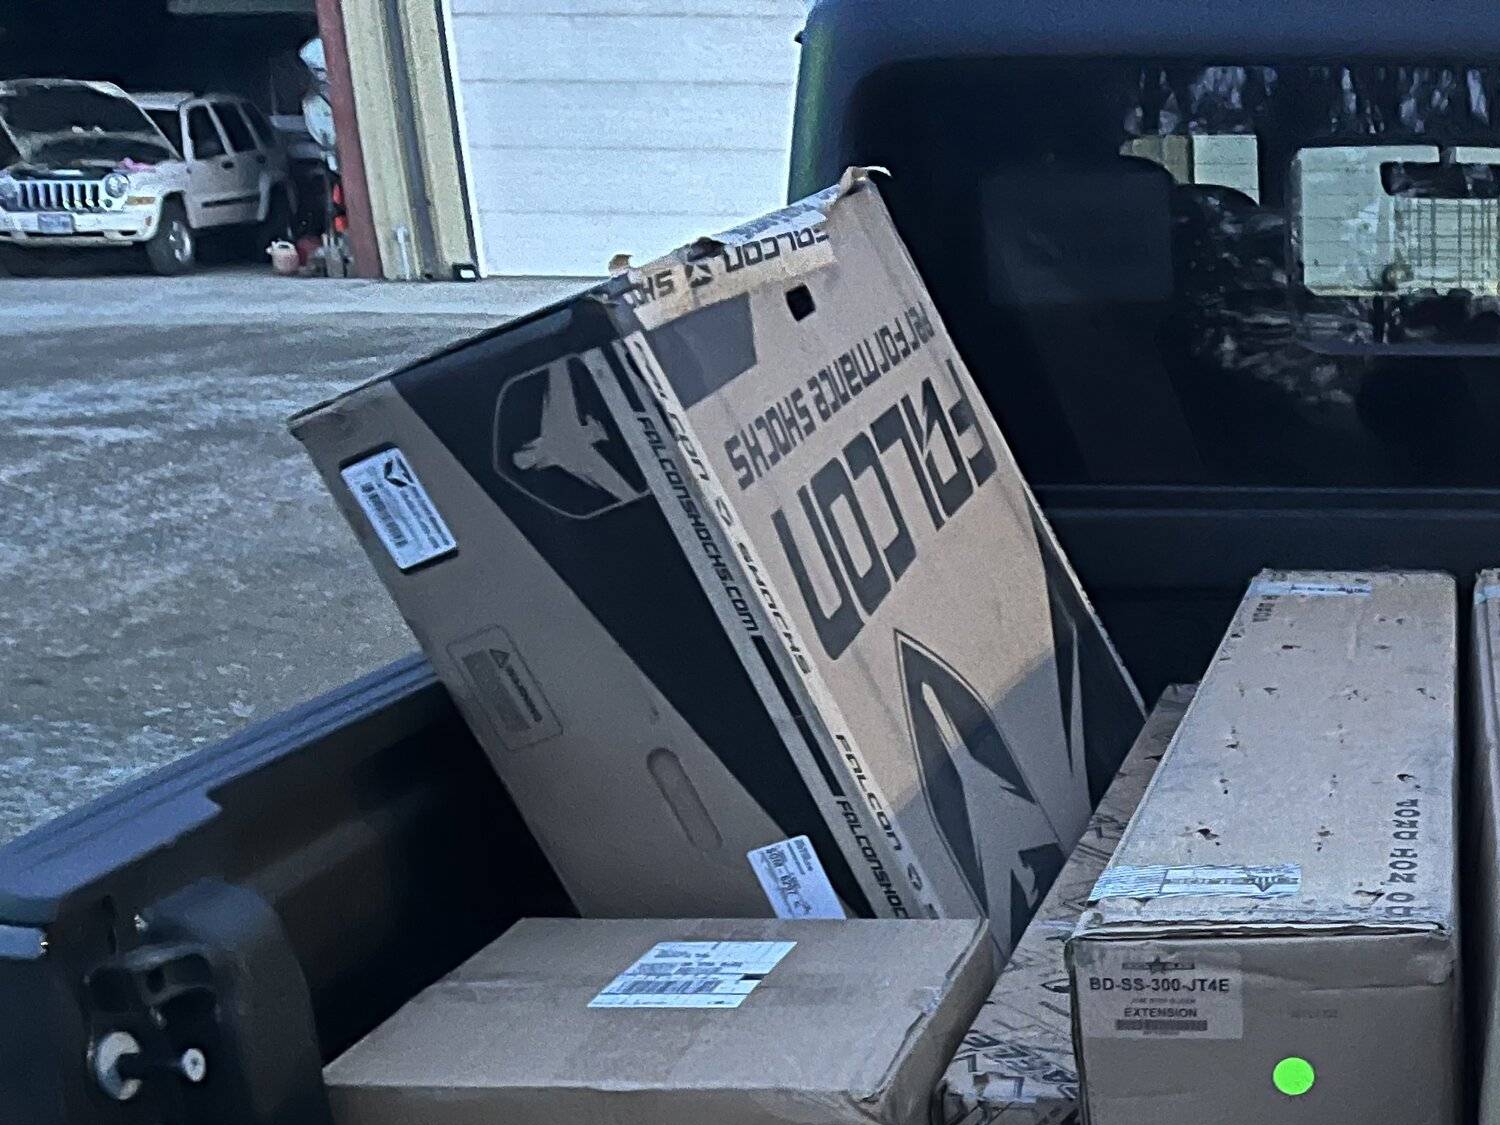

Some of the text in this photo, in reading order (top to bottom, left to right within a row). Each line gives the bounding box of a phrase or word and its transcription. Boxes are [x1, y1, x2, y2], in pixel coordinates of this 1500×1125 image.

[770, 357, 998, 661] FALCON
[1089, 976, 1230, 992] BD-SS-300-JT4E
[1124, 1007, 1198, 1018] EXTENSION
